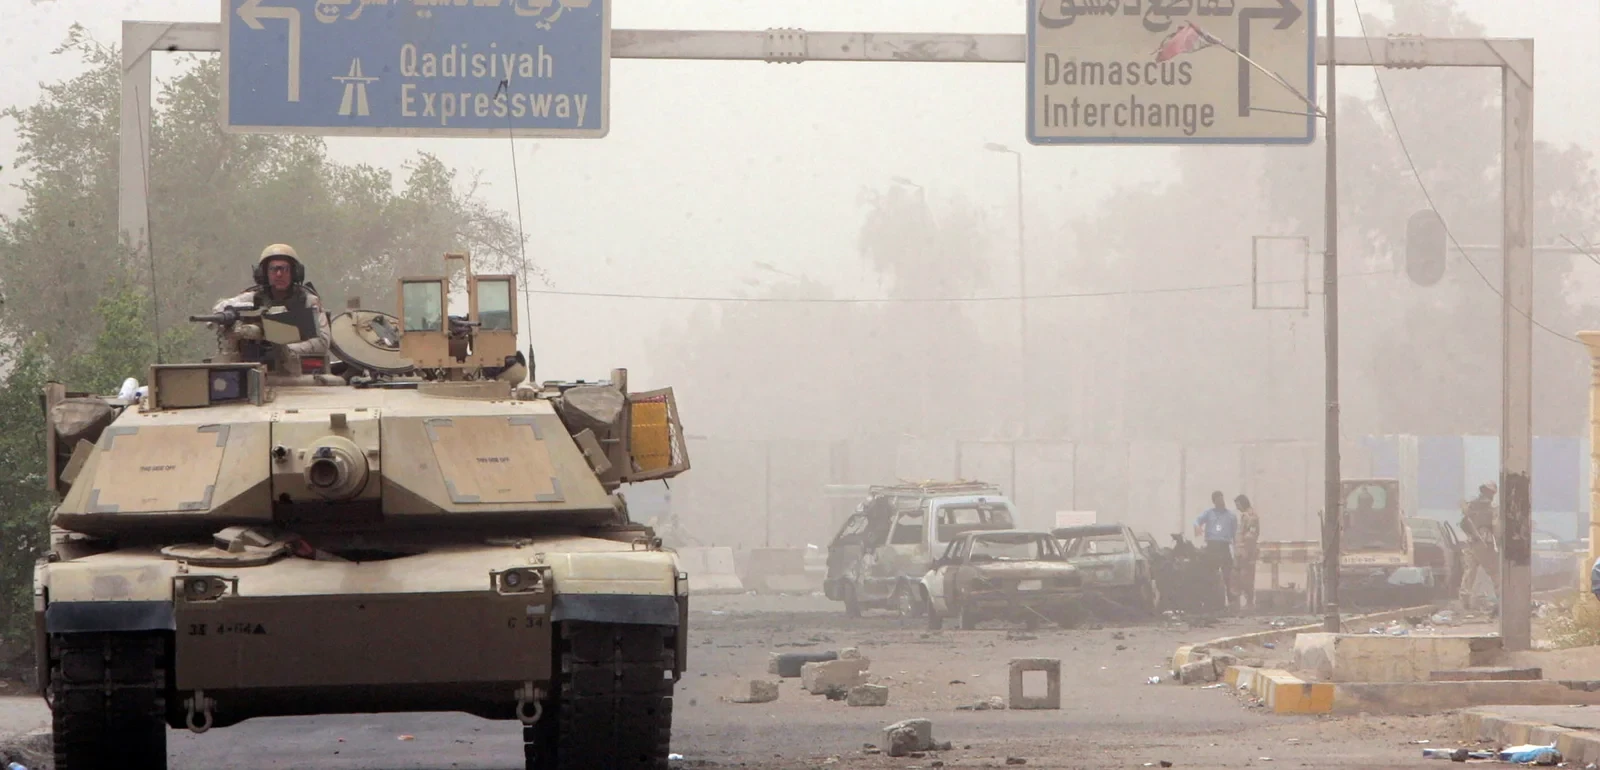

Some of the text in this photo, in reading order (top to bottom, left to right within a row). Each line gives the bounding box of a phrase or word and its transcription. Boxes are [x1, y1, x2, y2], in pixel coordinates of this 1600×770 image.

[400, 43, 553, 82] Qadisiyah
[1044, 53, 1193, 86] Damascus
[401, 84, 588, 127] Expressway
[1044, 95, 1215, 136] Interchange
